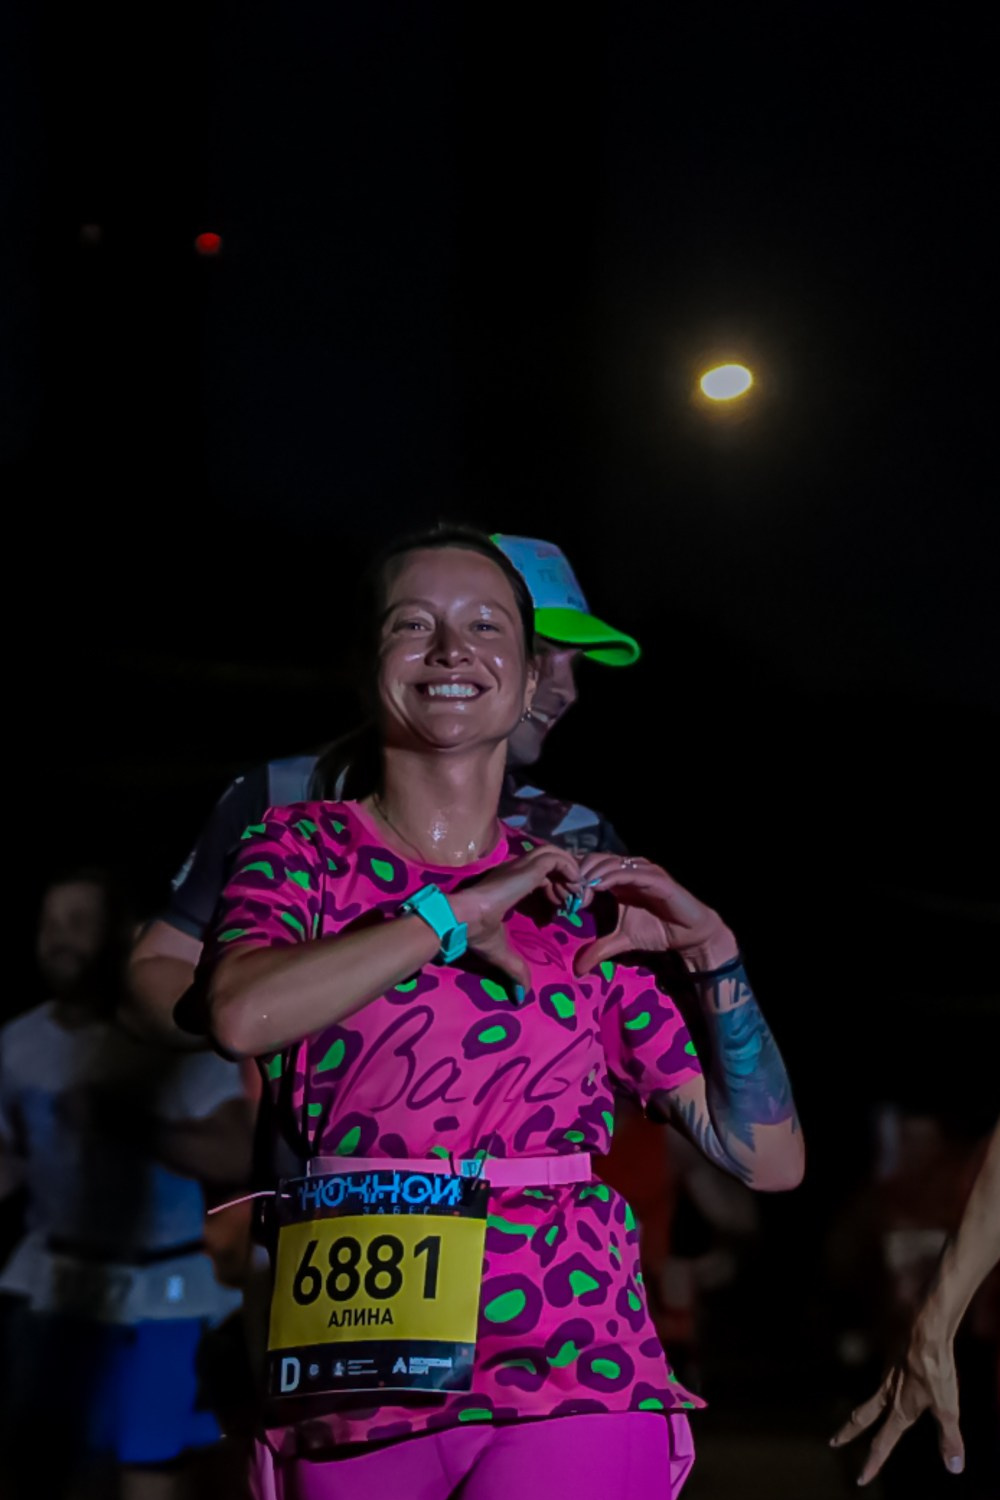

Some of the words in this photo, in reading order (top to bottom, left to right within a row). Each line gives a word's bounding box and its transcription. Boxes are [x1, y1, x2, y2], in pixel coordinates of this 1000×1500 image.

[292, 1234, 442, 1306] 6881
[327, 1307, 394, 1329] АЛИНА
[280, 1356, 300, 1393] D
